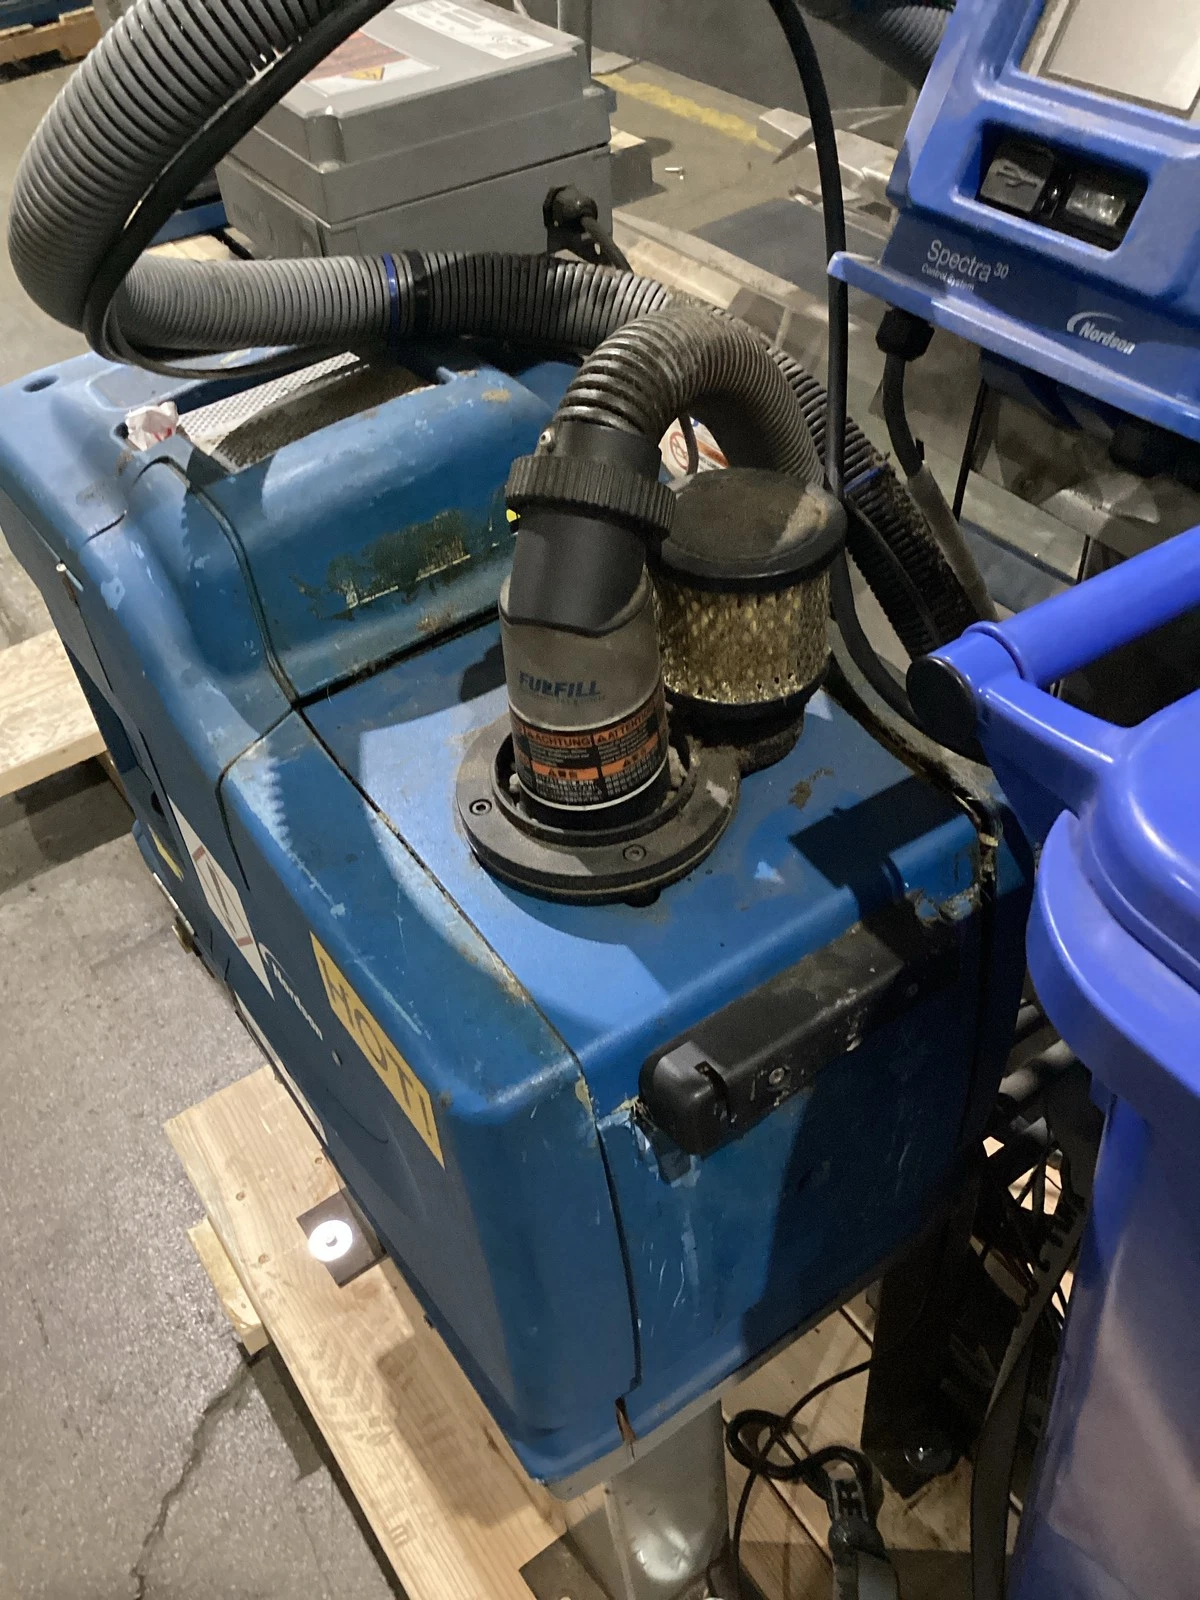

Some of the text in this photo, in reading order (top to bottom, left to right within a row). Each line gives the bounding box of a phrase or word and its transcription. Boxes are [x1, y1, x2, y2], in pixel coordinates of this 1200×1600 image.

[927, 239, 991, 283] Spectra
[1079, 321, 1136, 355] Nordson
[535, 732, 590, 747] ACHTUNG
[319, 956, 432, 1138] HOT!
